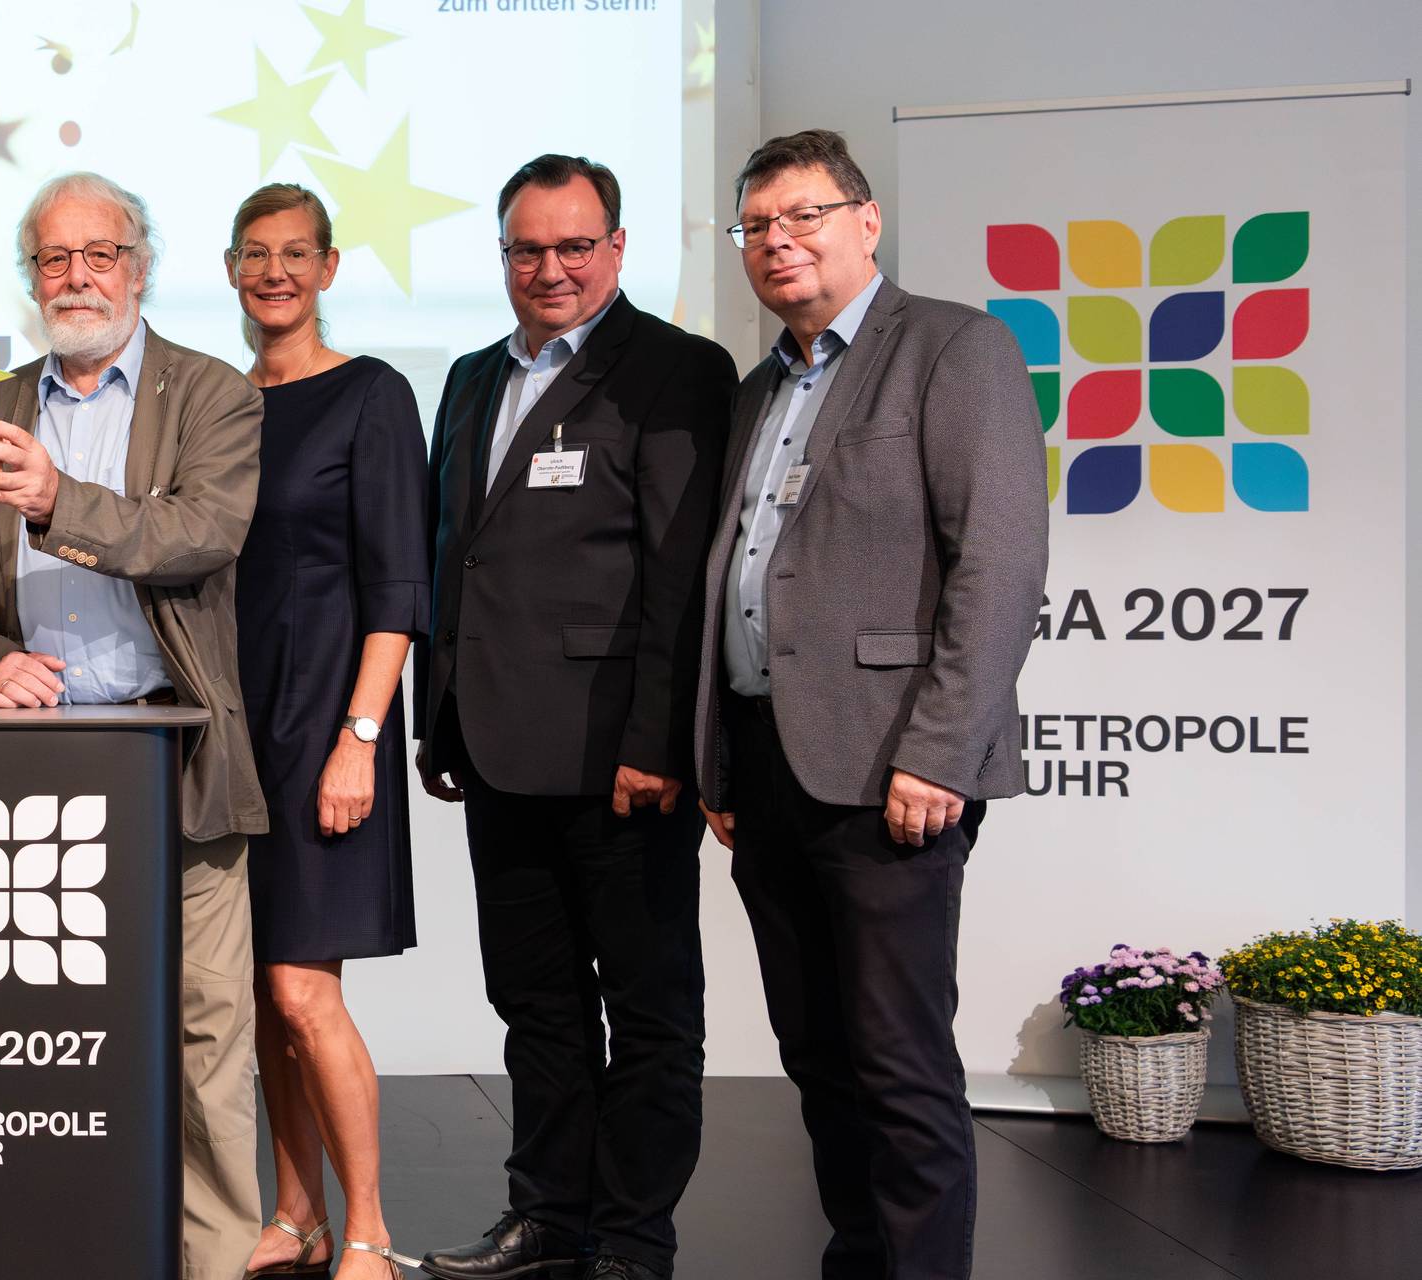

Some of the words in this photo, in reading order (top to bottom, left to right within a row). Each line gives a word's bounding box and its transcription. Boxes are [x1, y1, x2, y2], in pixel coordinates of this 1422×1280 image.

[438, 0, 487, 12] zum
[496, 0, 575, 11] dritten
[1125, 588, 1309, 641] 2027
[1023, 760, 1130, 798] UHR
[0, 1031, 107, 1066] 2027
